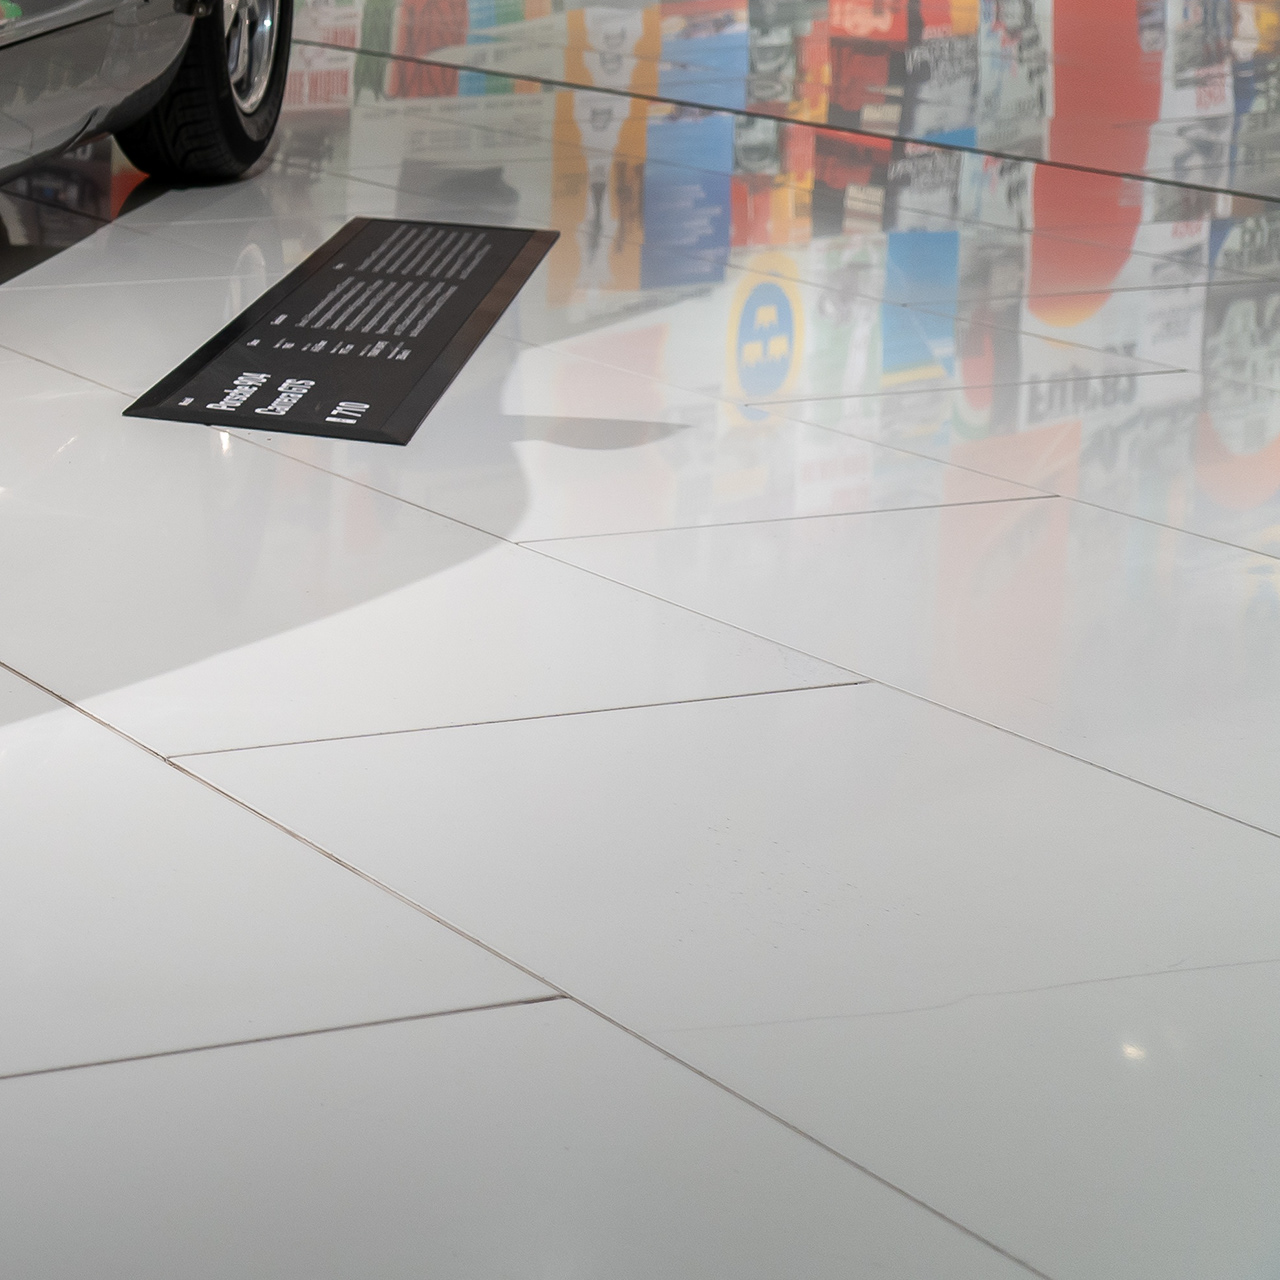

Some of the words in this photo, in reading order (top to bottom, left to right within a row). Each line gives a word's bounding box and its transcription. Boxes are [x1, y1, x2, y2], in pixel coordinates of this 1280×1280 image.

[202, 383, 259, 411] Porsche
[251, 391, 304, 416] Carrera
[329, 400, 373, 417] 710
